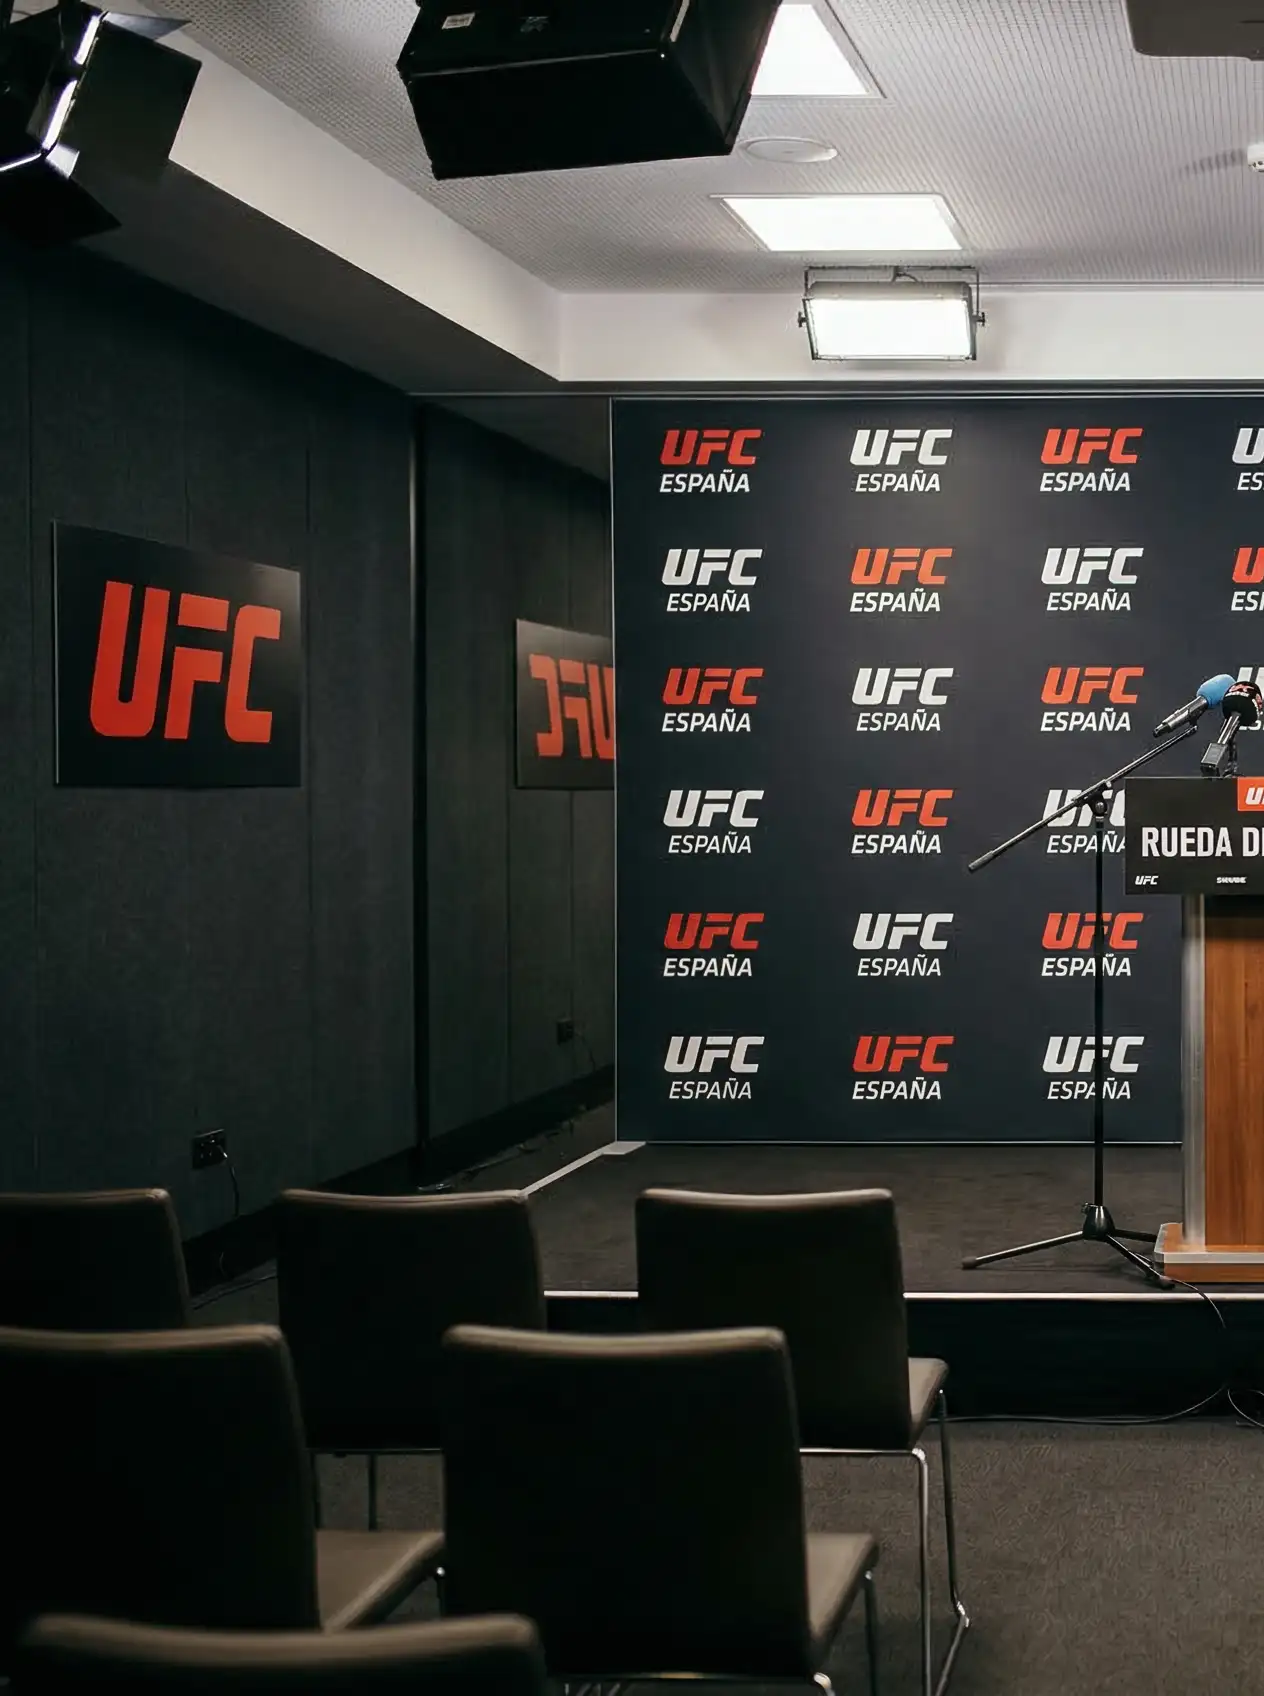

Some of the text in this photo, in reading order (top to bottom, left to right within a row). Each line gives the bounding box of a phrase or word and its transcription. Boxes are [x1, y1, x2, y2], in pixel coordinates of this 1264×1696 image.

[660, 429, 762, 466] UFC
[849, 428, 953, 466] UFC
[1040, 427, 1144, 465] UFC
[659, 468, 750, 493] ESPAÑA
[854, 469, 941, 493] ESPAÑA
[1039, 467, 1131, 492] ESPAÑA
[661, 548, 763, 586] UFC
[850, 547, 954, 586] UFC
[1040, 547, 1145, 585] UFC
[666, 589, 751, 612] ESPAÑA
[849, 587, 941, 613] ESPAÑA
[1046, 587, 1131, 612] ESPAÑA
[90, 580, 281, 743] UFC
[662, 667, 764, 705] UFC
[851, 667, 955, 706] UFC
[1040, 666, 1145, 705] UFC
[661, 708, 751, 733] ESPAÑA
[856, 708, 941, 732] ESPAÑA
[1040, 707, 1131, 732] ESPAÑA
[663, 789, 765, 828] UFC
[851, 788, 954, 827] UFC
[668, 831, 752, 854] ESPAÑA
[851, 829, 942, 854] ESPAÑA
[1141, 826, 1233, 857] RUEDA
[1134, 875, 1159, 885] UFC
[663, 912, 765, 950] UFC
[852, 913, 954, 950] UFC
[1042, 913, 1144, 949] UFC
[663, 953, 753, 977] ESPAÑA
[857, 953, 942, 977] ESPAÑA
[1041, 954, 1131, 976] ESPAÑA
[663, 1036, 765, 1073] UFC
[852, 1035, 954, 1073] UFC
[1043, 1036, 1145, 1072] UFC
[669, 1077, 752, 1100] ESPAÑA
[852, 1076, 942, 1100] ESPAÑA
